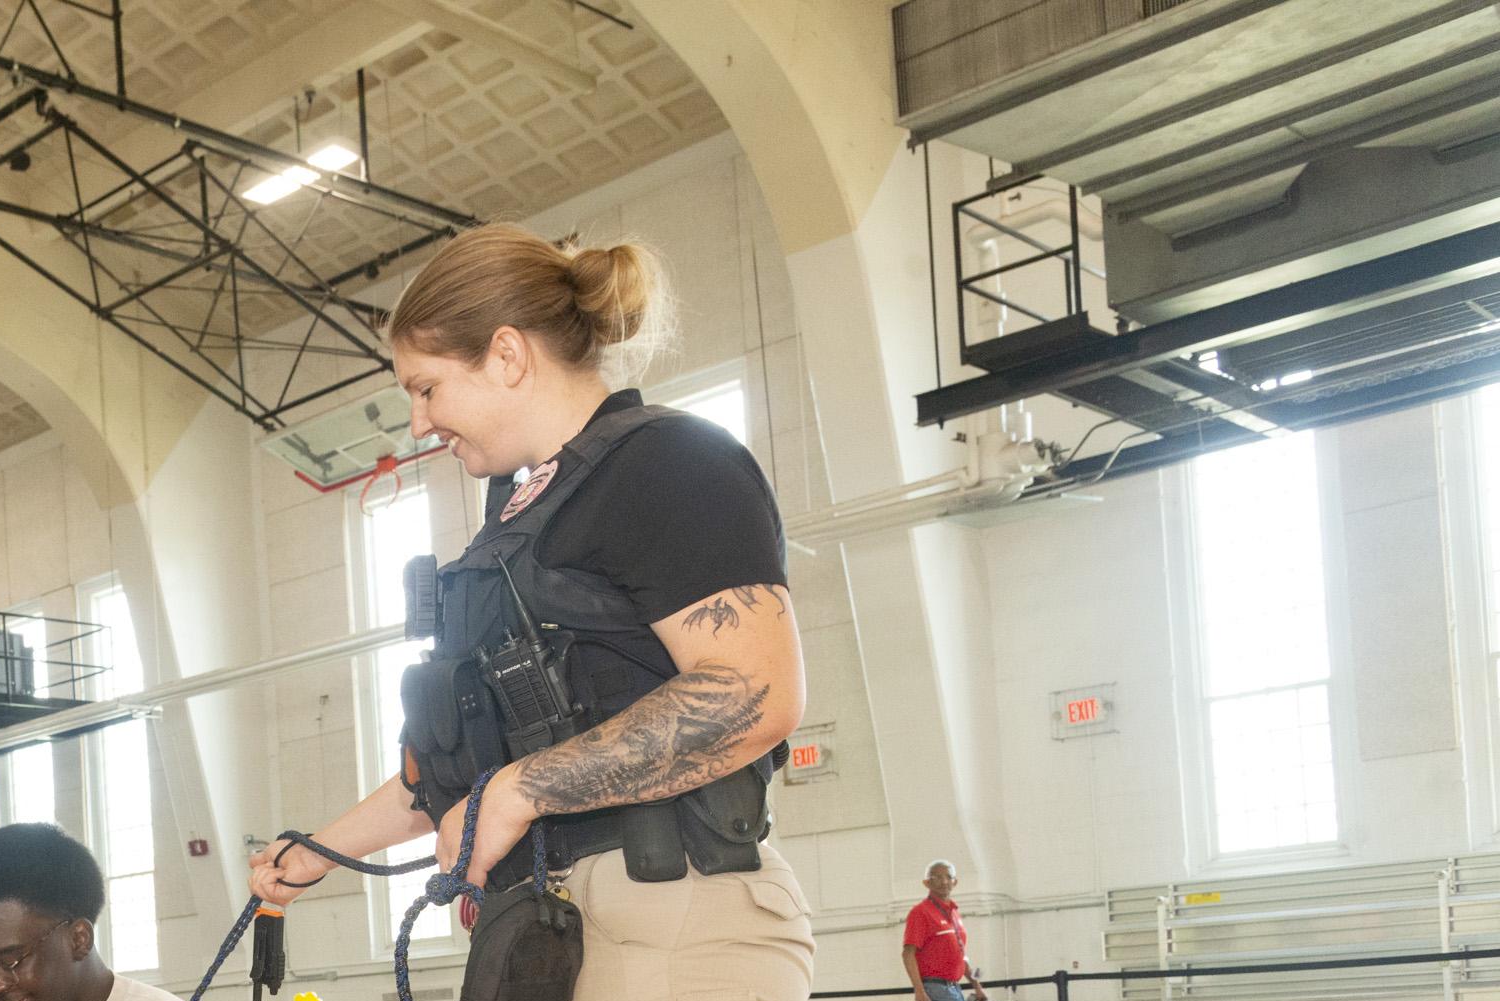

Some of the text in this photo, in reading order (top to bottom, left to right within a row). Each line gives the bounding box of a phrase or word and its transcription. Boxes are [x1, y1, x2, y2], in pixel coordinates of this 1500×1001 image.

[502, 660, 531, 675] MOTORLA
[1068, 698, 1096, 723] EXIT
[792, 745, 817, 768] EXIT
